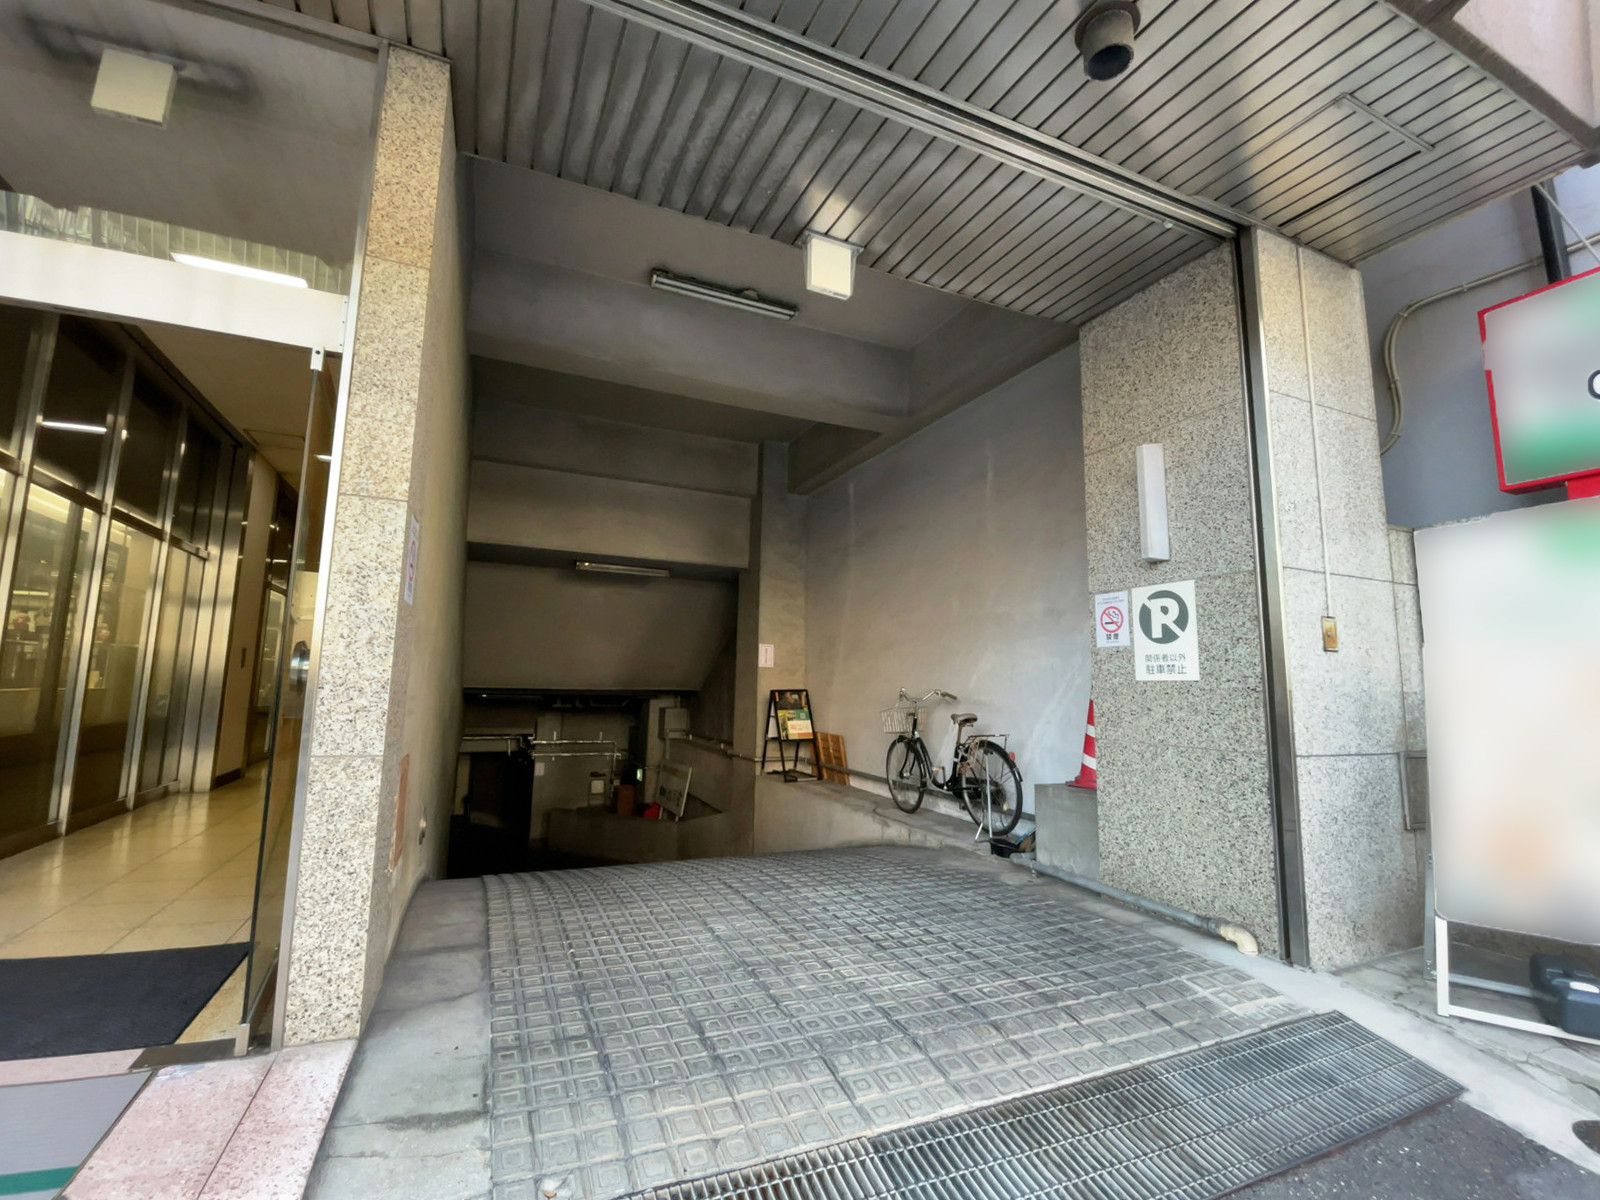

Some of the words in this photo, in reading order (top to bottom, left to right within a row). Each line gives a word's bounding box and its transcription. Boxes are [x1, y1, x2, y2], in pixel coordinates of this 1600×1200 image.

[1144, 653, 1186, 662] 関係者以外
[1145, 664, 1187, 674] 駐車禁止
